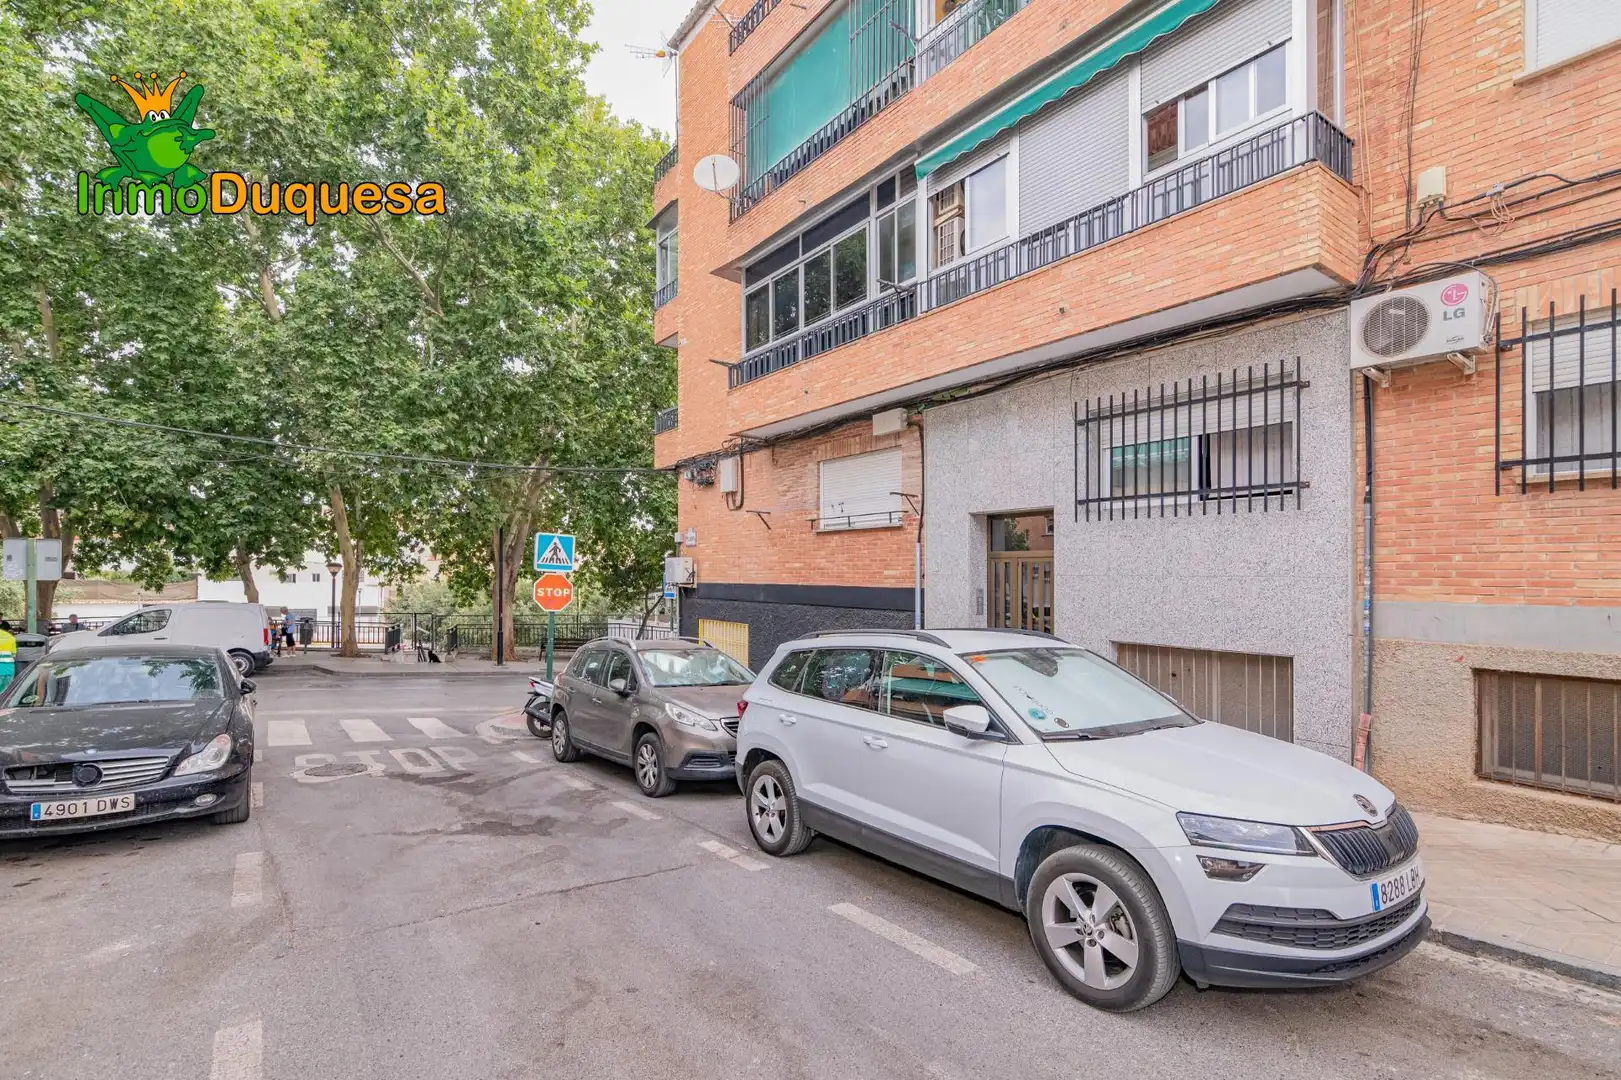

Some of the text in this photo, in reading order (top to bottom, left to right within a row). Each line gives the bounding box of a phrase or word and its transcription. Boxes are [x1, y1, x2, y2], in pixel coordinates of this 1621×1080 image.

[1443, 308, 1466, 321] LG
[537, 587, 571, 597] STOP
[44, 796, 130, 816] 4901 DWS
[1380, 865, 1420, 904] 8288 LBH
